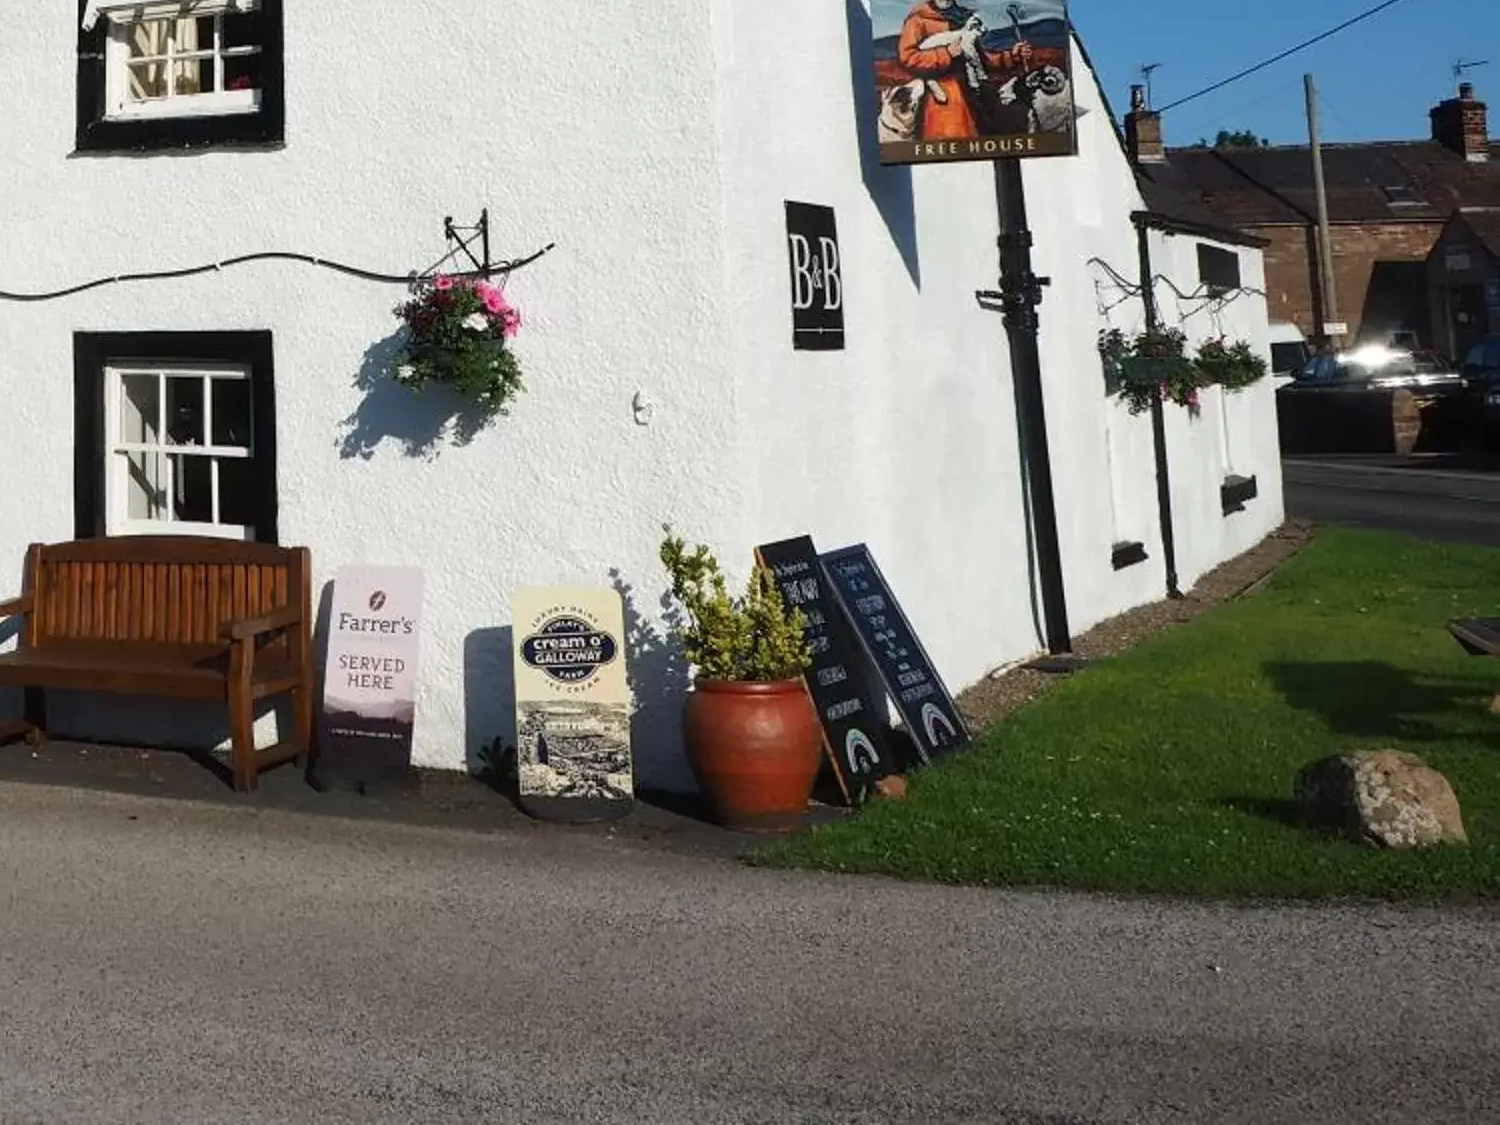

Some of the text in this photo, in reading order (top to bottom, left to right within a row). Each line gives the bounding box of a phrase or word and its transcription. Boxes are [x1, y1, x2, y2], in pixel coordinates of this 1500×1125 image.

[915, 138, 1037, 156] FREE HOUSE
[789, 233, 842, 310] B&B
[338, 612, 414, 634] Farrer's
[533, 635, 586, 650] cream
[339, 654, 405, 673] SERVED
[535, 650, 603, 664] GALLOWAY
[346, 672, 395, 690] HERE
